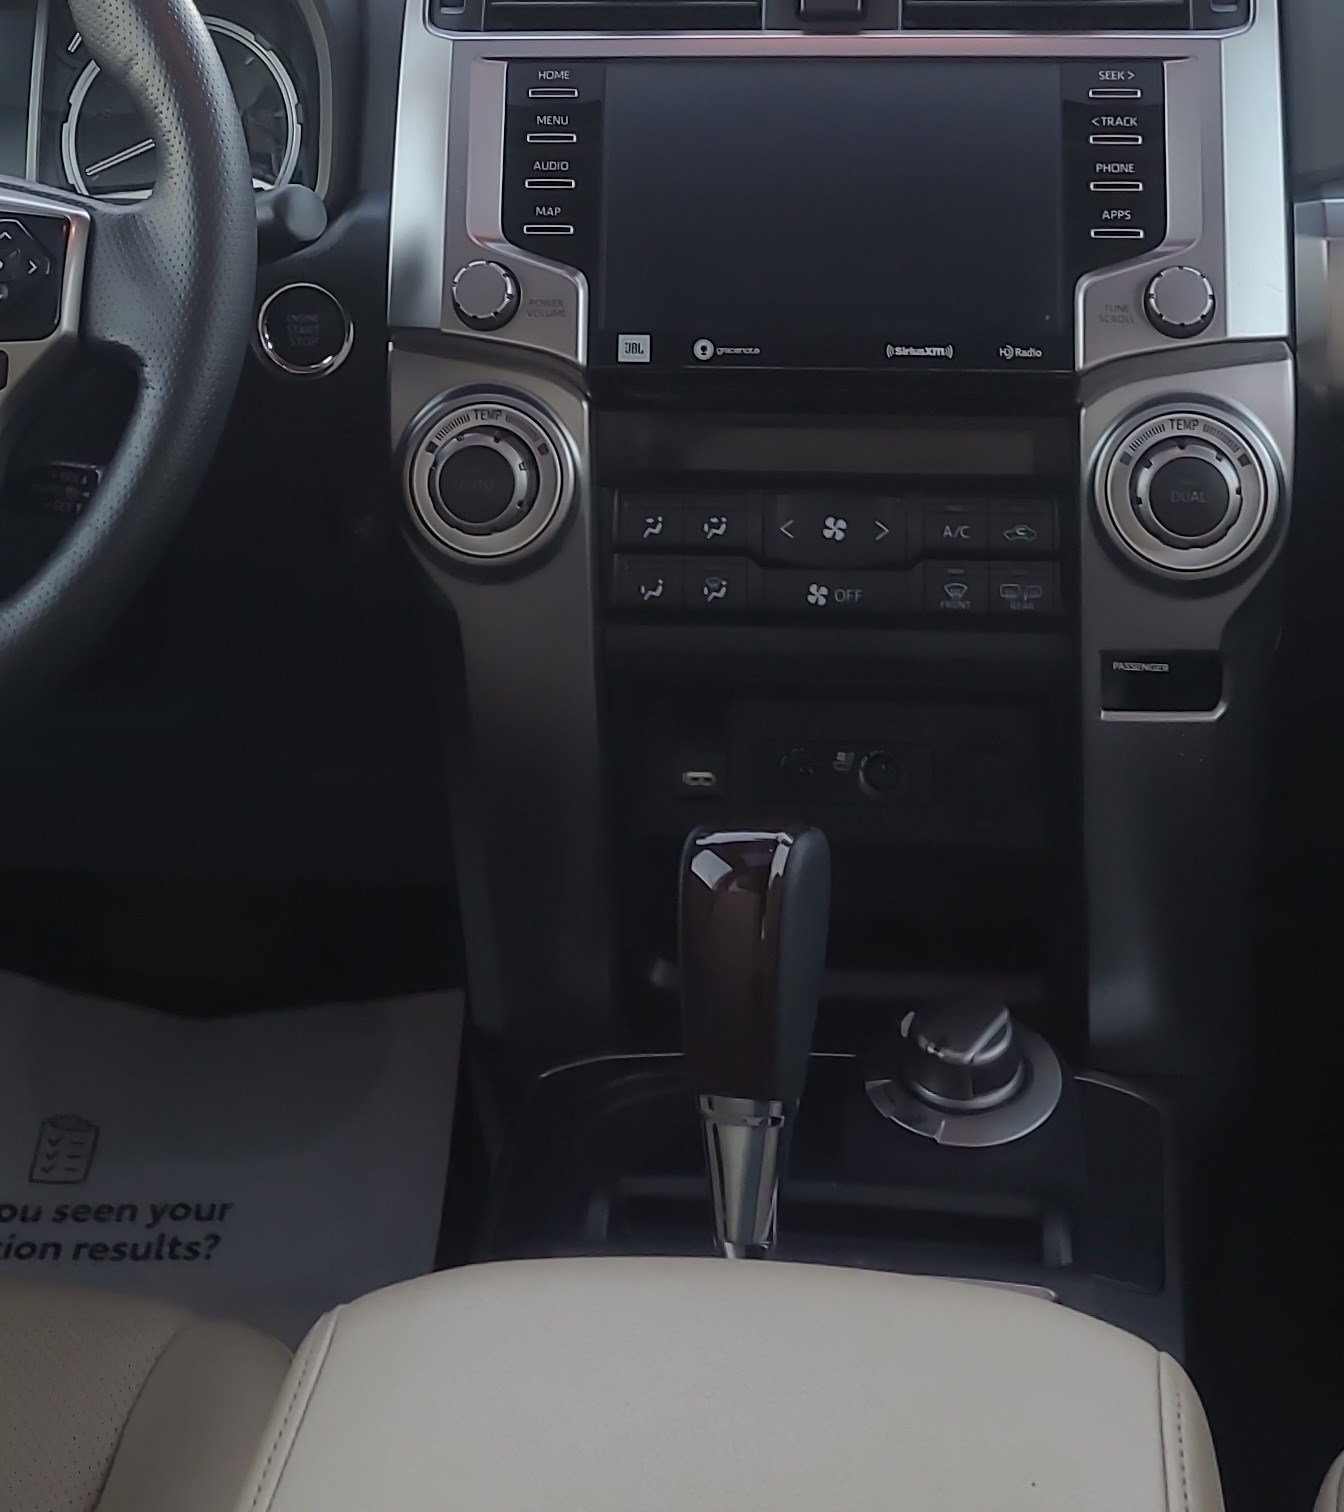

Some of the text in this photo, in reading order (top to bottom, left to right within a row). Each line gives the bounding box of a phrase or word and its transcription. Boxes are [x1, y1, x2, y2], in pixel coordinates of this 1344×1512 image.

[537, 70, 571, 80] HOME
[536, 115, 570, 126] MENU
[533, 161, 570, 171] AUDIO
[1095, 163, 1136, 174] PHONE
[535, 206, 562, 217] MAP
[1101, 210, 1132, 221] APPS
[529, 298, 565, 308] POWER
[526, 309, 567, 318] VOLUME
[1098, 314, 1136, 324] SCROLL
[624, 342, 645, 355] JBL
[1015, 347, 1043, 358] Radio
[473, 408, 503, 421] TEMP
[1167, 418, 1200, 431] TEMP
[942, 524, 971, 539] A/C
[834, 588, 863, 603] OFF
[51, 1199, 138, 1225] seen
[144, 1199, 235, 1229] your
[71, 1232, 222, 1263] results?
